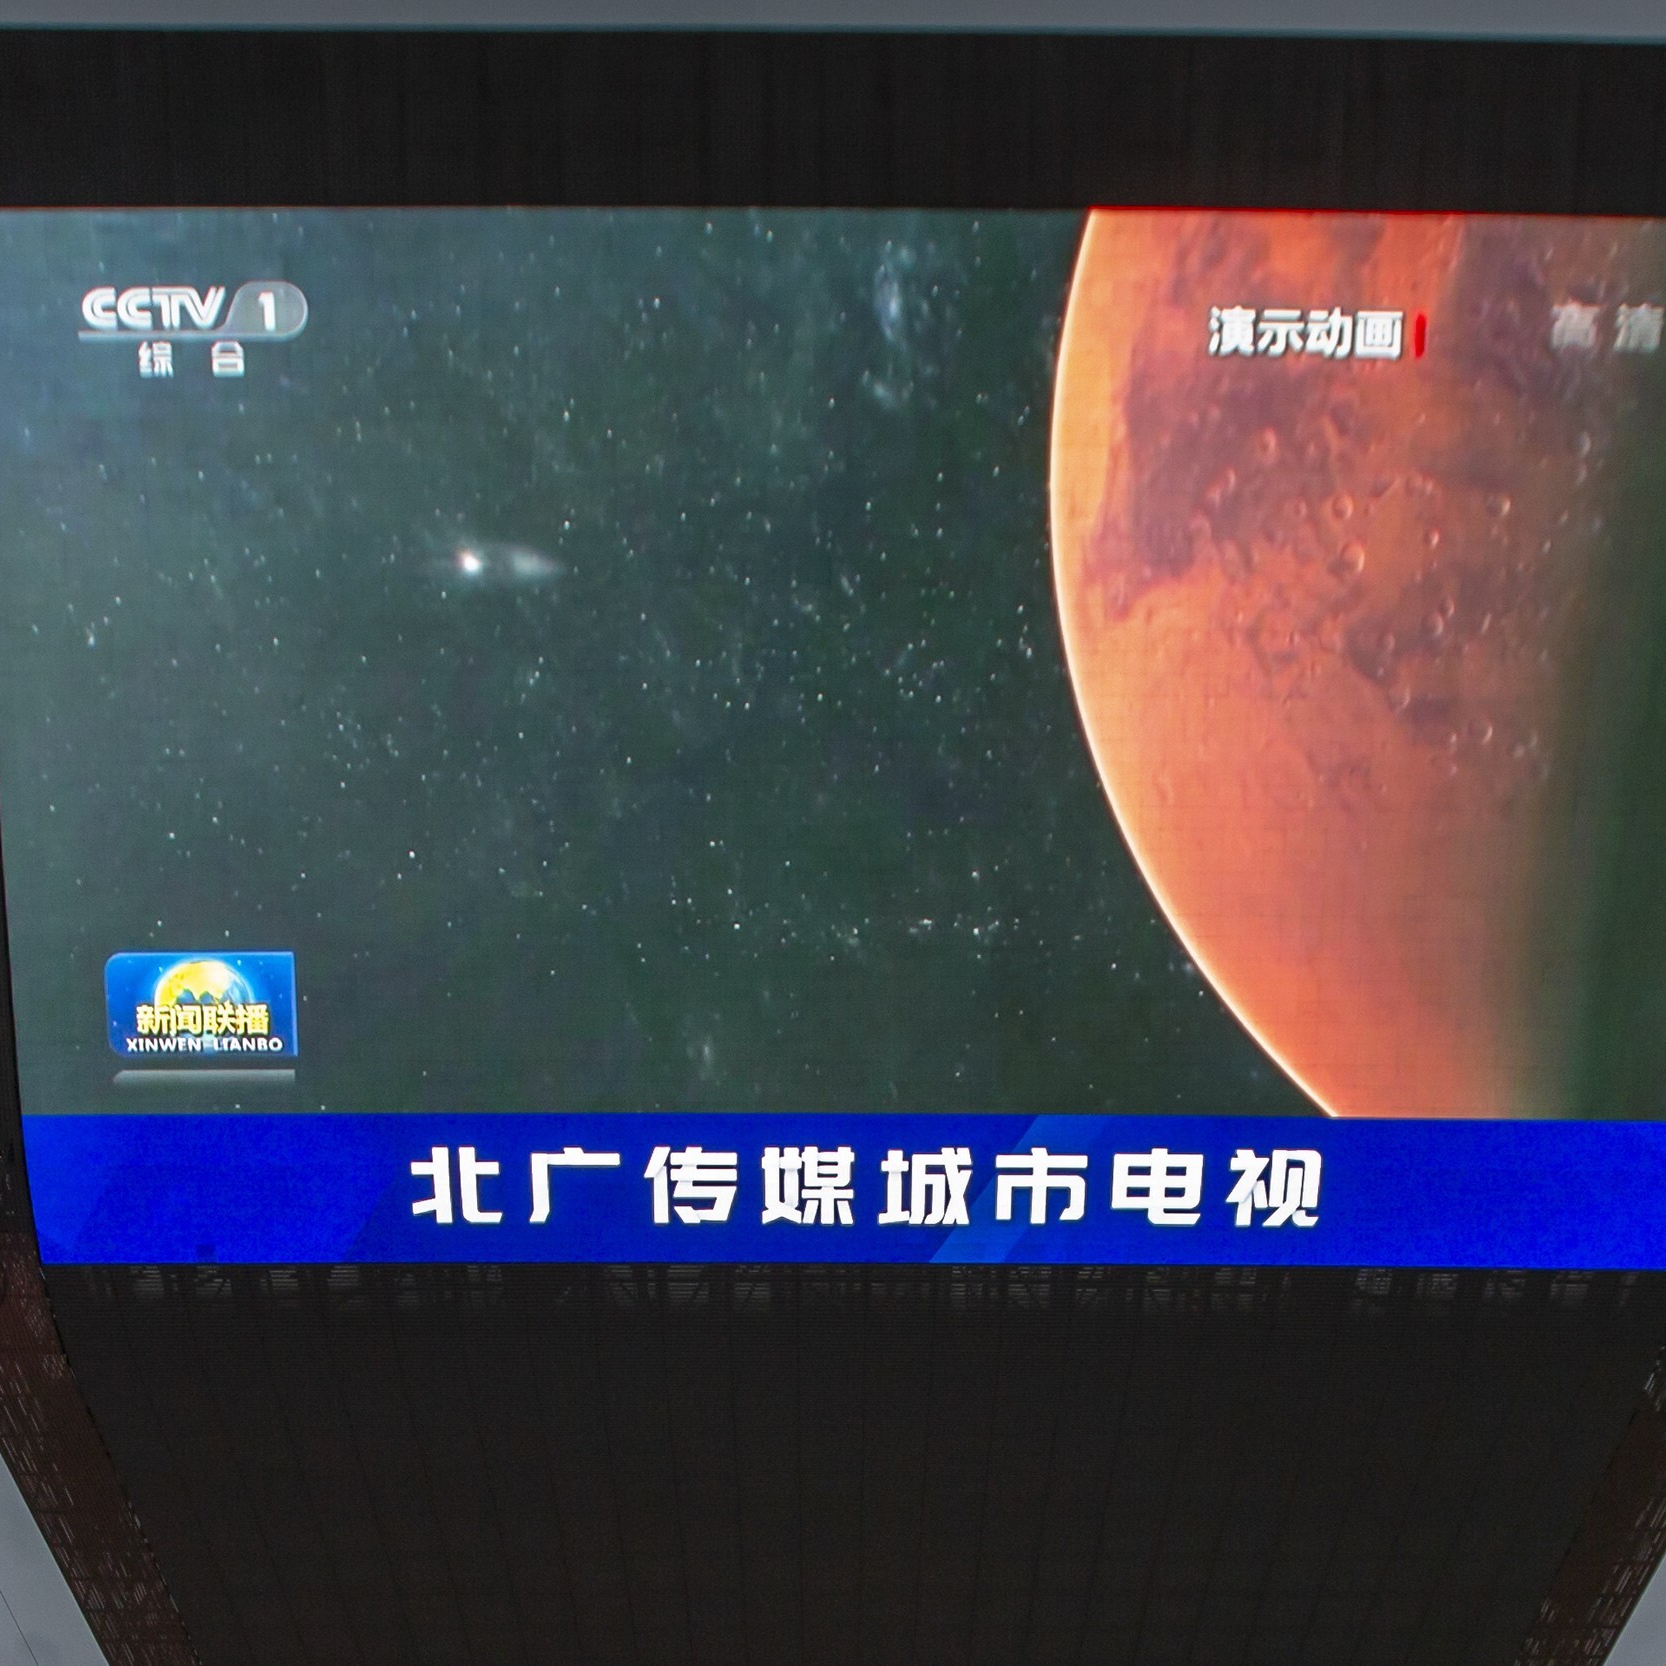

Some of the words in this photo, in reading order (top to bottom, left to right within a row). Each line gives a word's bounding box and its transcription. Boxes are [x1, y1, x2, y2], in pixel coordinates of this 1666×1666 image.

[82, 286, 226, 331] CCTV
[259, 291, 276, 332] 1
[1208, 306, 1404, 360] 演示动画
[138, 341, 245, 379] 综合
[136, 1003, 270, 1036] 新闻联播
[126, 1037, 203, 1053] XINWEN
[212, 1037, 284, 1052] LIANBO
[409, 1146, 1323, 1229] 北广传媒城市电视
